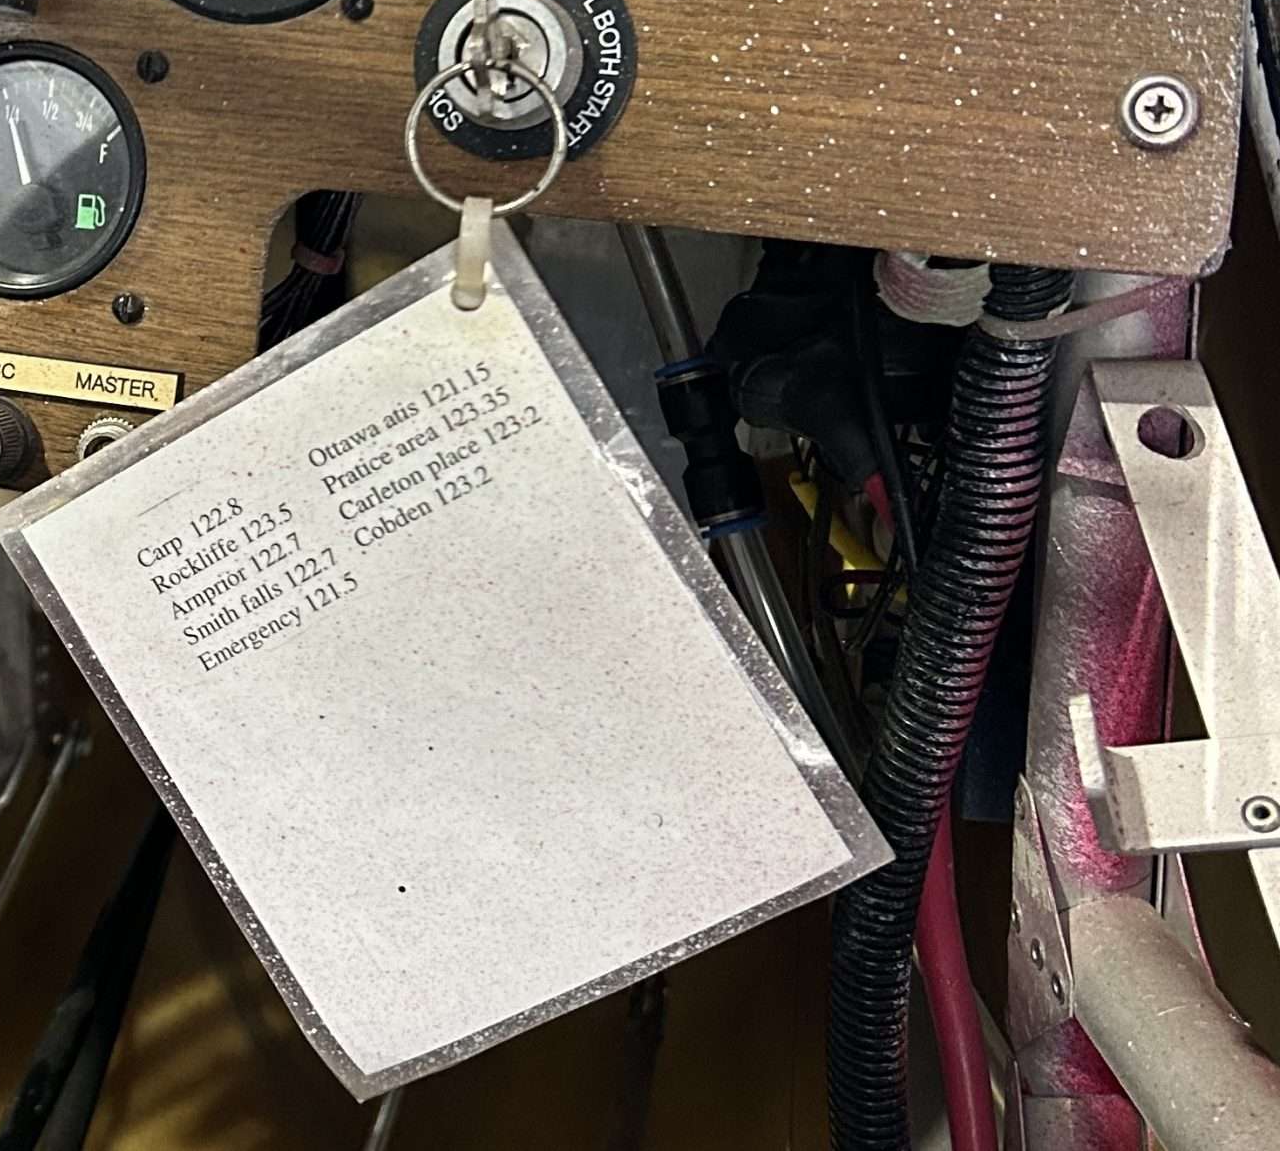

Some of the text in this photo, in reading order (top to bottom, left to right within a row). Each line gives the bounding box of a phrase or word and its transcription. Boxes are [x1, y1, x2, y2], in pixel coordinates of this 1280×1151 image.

[592, 9, 621, 76] BOTH
[42, 100, 59, 120] 1/2
[76, 112, 93, 131] 3/4
[568, 79, 615, 147] START
[99, 144, 108, 164] F
[308, 362, 491, 467] Ottawa atis 121.15
[321, 386, 510, 495] Pratice area 123.35
[338, 405, 542, 521] Carleton place 123.2
[137, 497, 243, 568] Carp 122.8
[150, 502, 293, 595] Rockliffe 123.5
[354, 465, 493, 548] Cobden 123.2
[171, 532, 302, 620] Arnprior 122.7
[183, 547, 337, 646] Smith falls 122.7
[197, 571, 359, 672] Emergency 121.5
